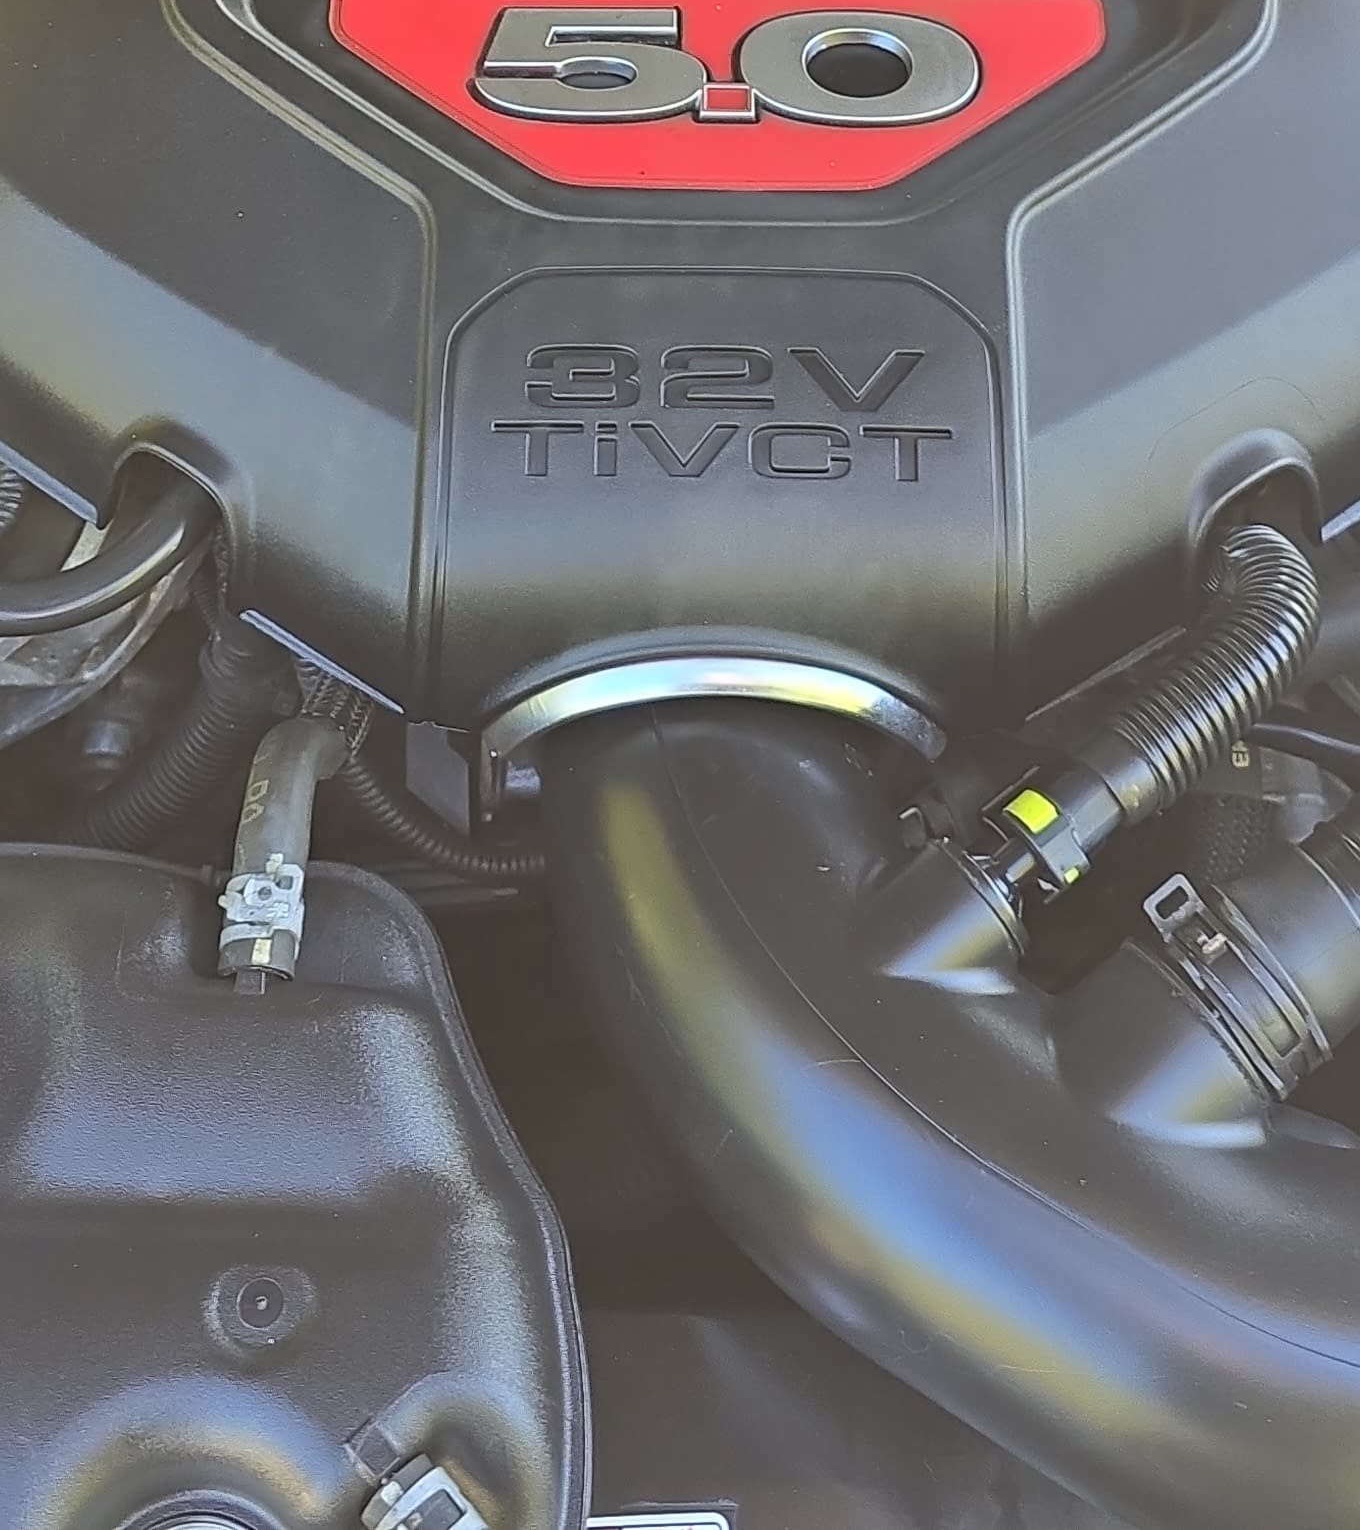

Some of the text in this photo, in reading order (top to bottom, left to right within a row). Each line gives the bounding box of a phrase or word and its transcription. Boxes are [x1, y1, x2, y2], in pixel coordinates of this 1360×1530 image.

[466, 5, 985, 130] 5.0
[525, 343, 927, 412] 32V
[490, 420, 955, 482] TiVCT
